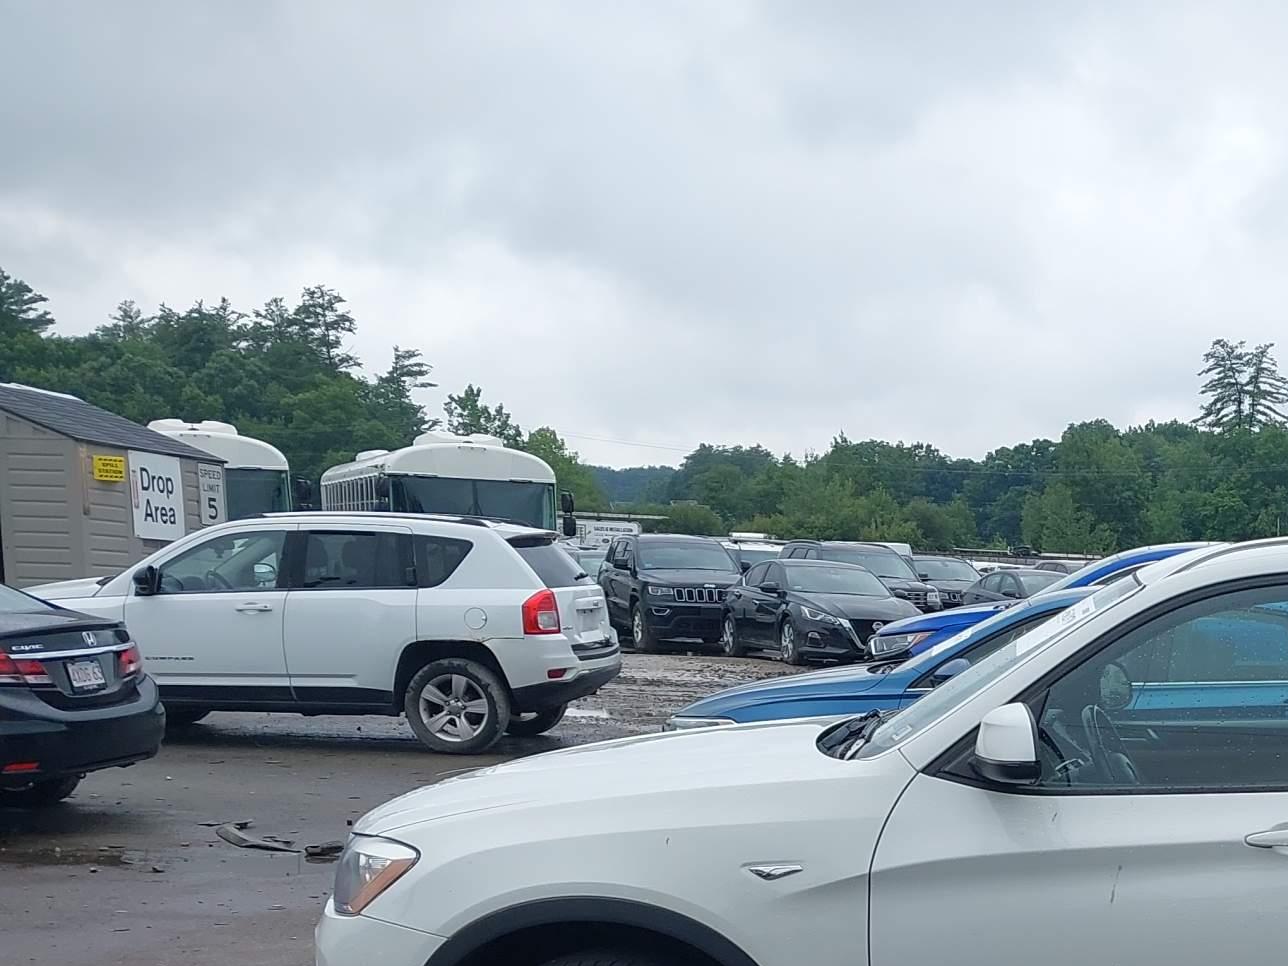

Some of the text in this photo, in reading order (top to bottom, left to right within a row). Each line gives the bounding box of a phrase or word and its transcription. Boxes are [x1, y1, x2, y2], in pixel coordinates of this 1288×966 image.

[199, 468, 221, 480] SPEED
[139, 466, 174, 500] Drop
[202, 484, 220, 493] LIMIT
[144, 498, 176, 525] Area
[207, 497, 218, 520] 5
[11, 643, 44, 651] CIVIC
